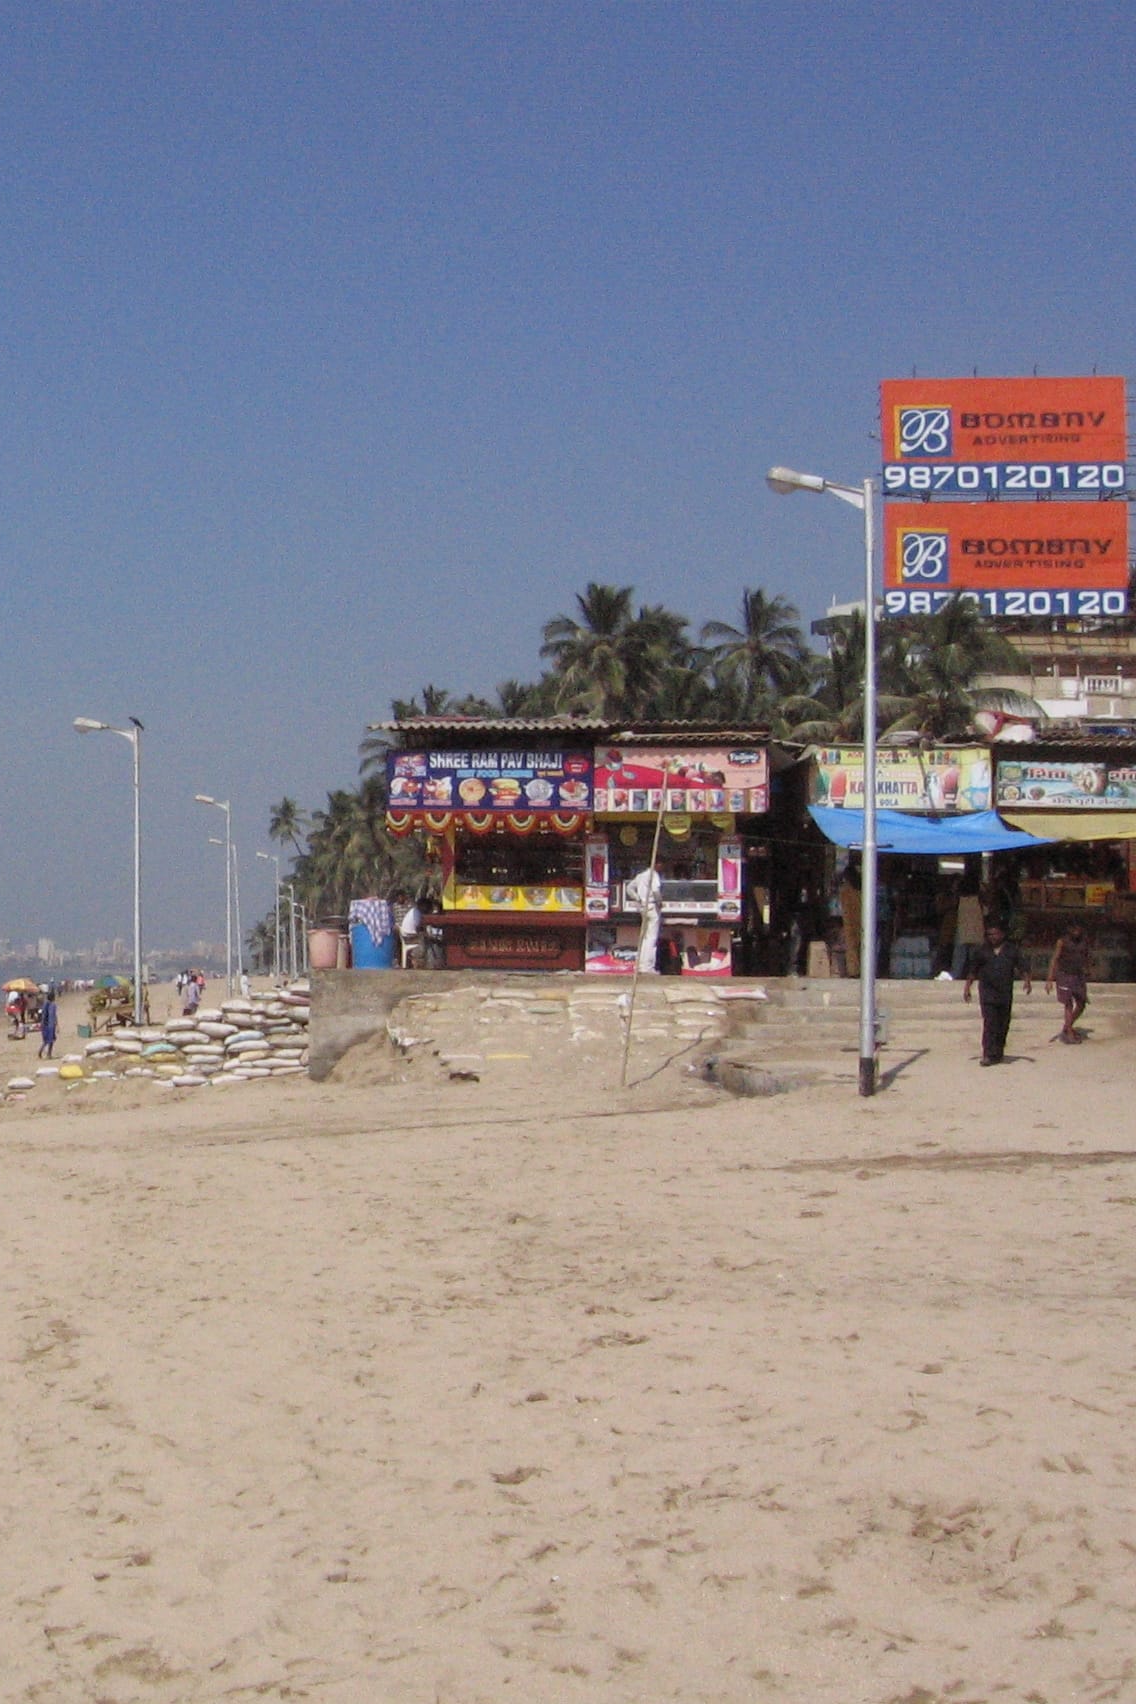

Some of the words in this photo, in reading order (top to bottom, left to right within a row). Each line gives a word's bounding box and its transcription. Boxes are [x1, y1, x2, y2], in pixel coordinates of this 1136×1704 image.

[972, 434, 1082, 446] ADVERTISING
[884, 465, 1125, 489] 9870120120
[974, 559, 1085, 569] ADVERTISING
[429, 752, 468, 769] SHREE
[471, 752, 498, 769] RAM
[501, 752, 524, 769] PAV
[526, 752, 563, 770] BHAJI
[850, 781, 918, 795] KAKHATTA
